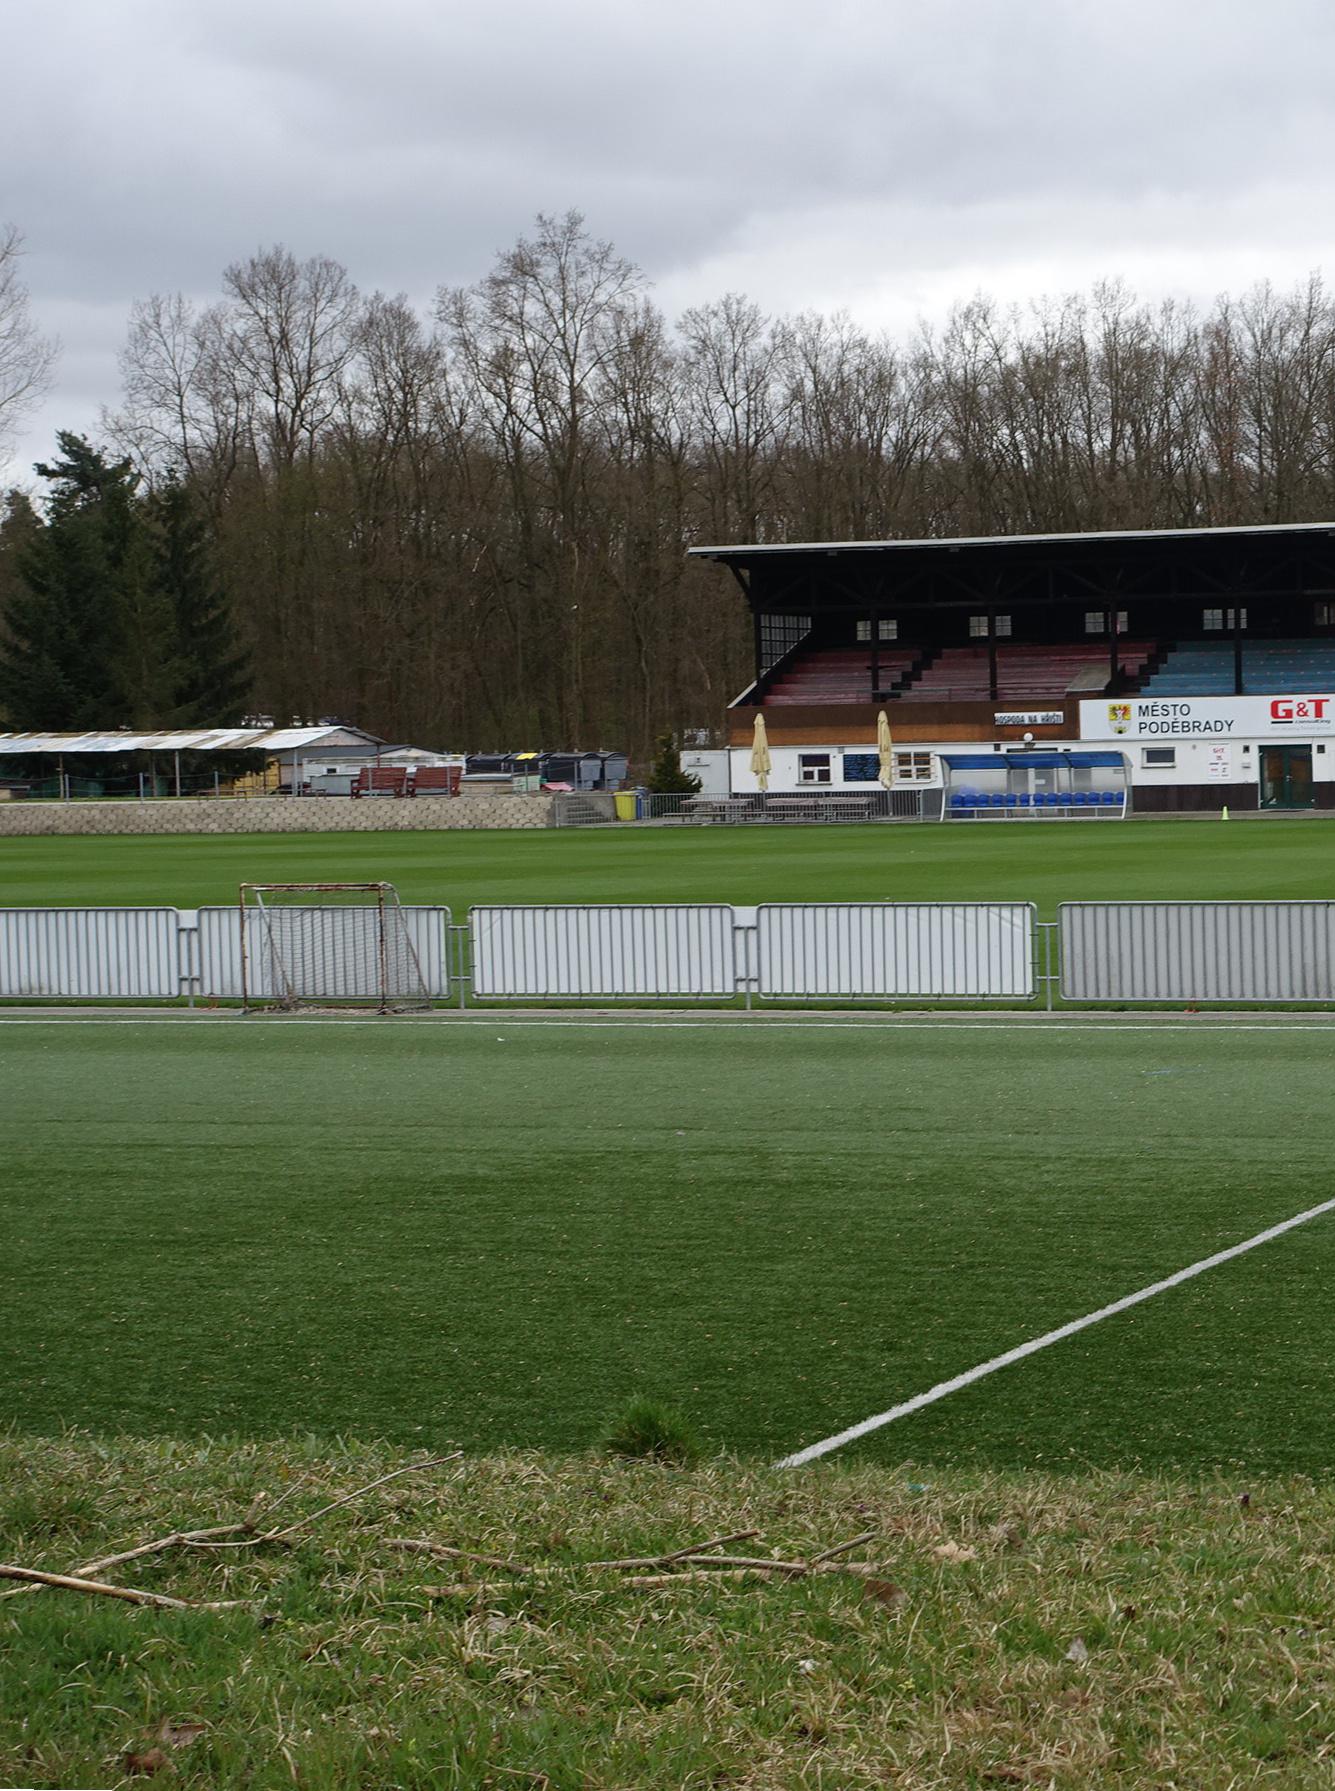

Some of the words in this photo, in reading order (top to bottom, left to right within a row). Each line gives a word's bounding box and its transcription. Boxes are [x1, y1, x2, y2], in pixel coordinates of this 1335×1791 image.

[1138, 701, 1191, 717] MĚSTO
[1271, 699, 1330, 719] G&T
[1139, 718, 1235, 734] PODĚBRADY
